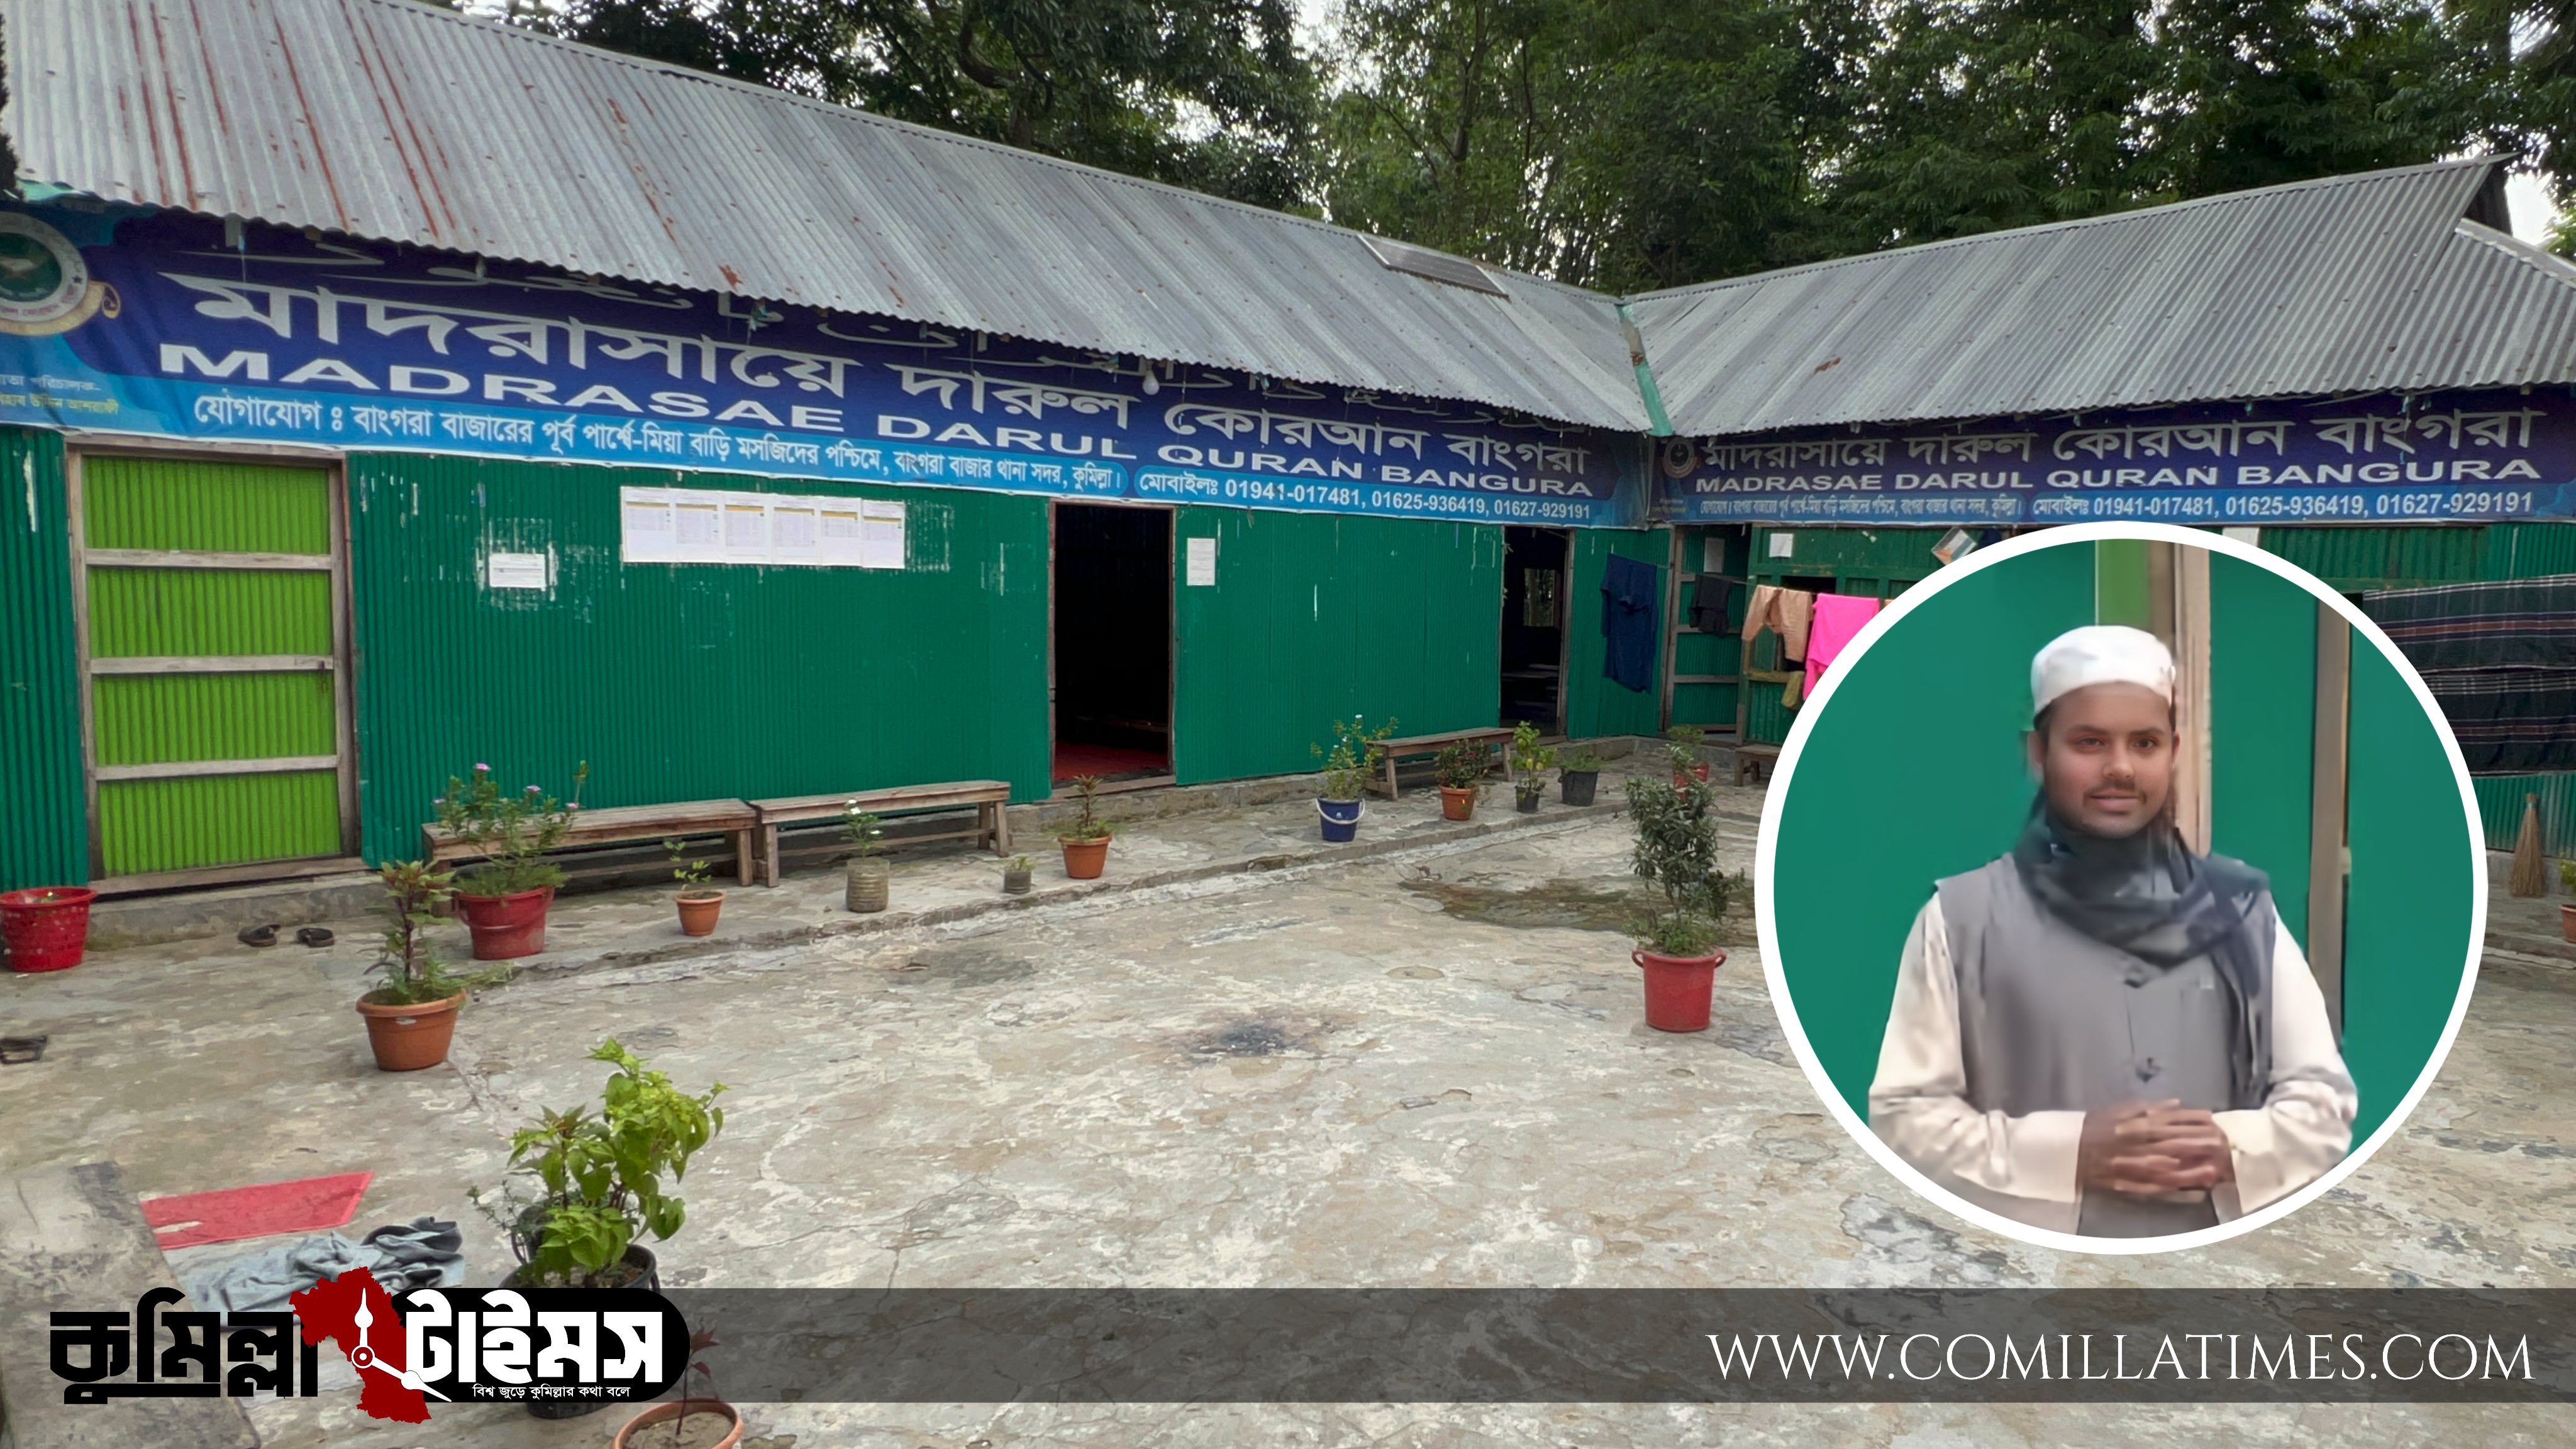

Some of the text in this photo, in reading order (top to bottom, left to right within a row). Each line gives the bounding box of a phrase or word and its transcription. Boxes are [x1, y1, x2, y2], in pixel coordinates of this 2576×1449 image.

[157, 272, 863, 397] মাদরাসায়ে
[883, 363, 1141, 429] দারুল
[1164, 403, 1431, 460] কোরআন
[1443, 428, 1590, 475] বাংগরা
[160, 343, 844, 431] MADRASAE
[878, 414, 1136, 459] DARUL
[1158, 445, 1362, 479] QURAN
[1381, 465, 1592, 496] BANGURA
[194, 394, 323, 430] যোগাযোগ
[350, 405, 434, 437] বাংগরা
[439, 412, 535, 444] বাজারের
[541, 415, 577, 454] পূর্ব
[689, 427, 731, 462] বাড়ি
[736, 433, 820, 465] মসজিদের
[893, 450, 944, 476] বাংগরা
[949, 455, 992, 479] বাজার
[997, 458, 1026, 483] থানা
[1700, 408, 2548, 471] মাদরাসায়ে দারুল কোরআন বাংগরা
[1225, 479, 1366, 508] 01941-017481,
[1372, 490, 1490, 517] 01625-936419,
[1494, 499, 1590, 519] 01627-929191
[1696, 459, 2541, 492] MADRASAE DARUL QURAN BANGURA
[2094, 497, 2219, 518] 01941-017481,
[2225, 495, 2369, 518] 01625-936419,
[2376, 492, 2533, 514] 01627-929191
